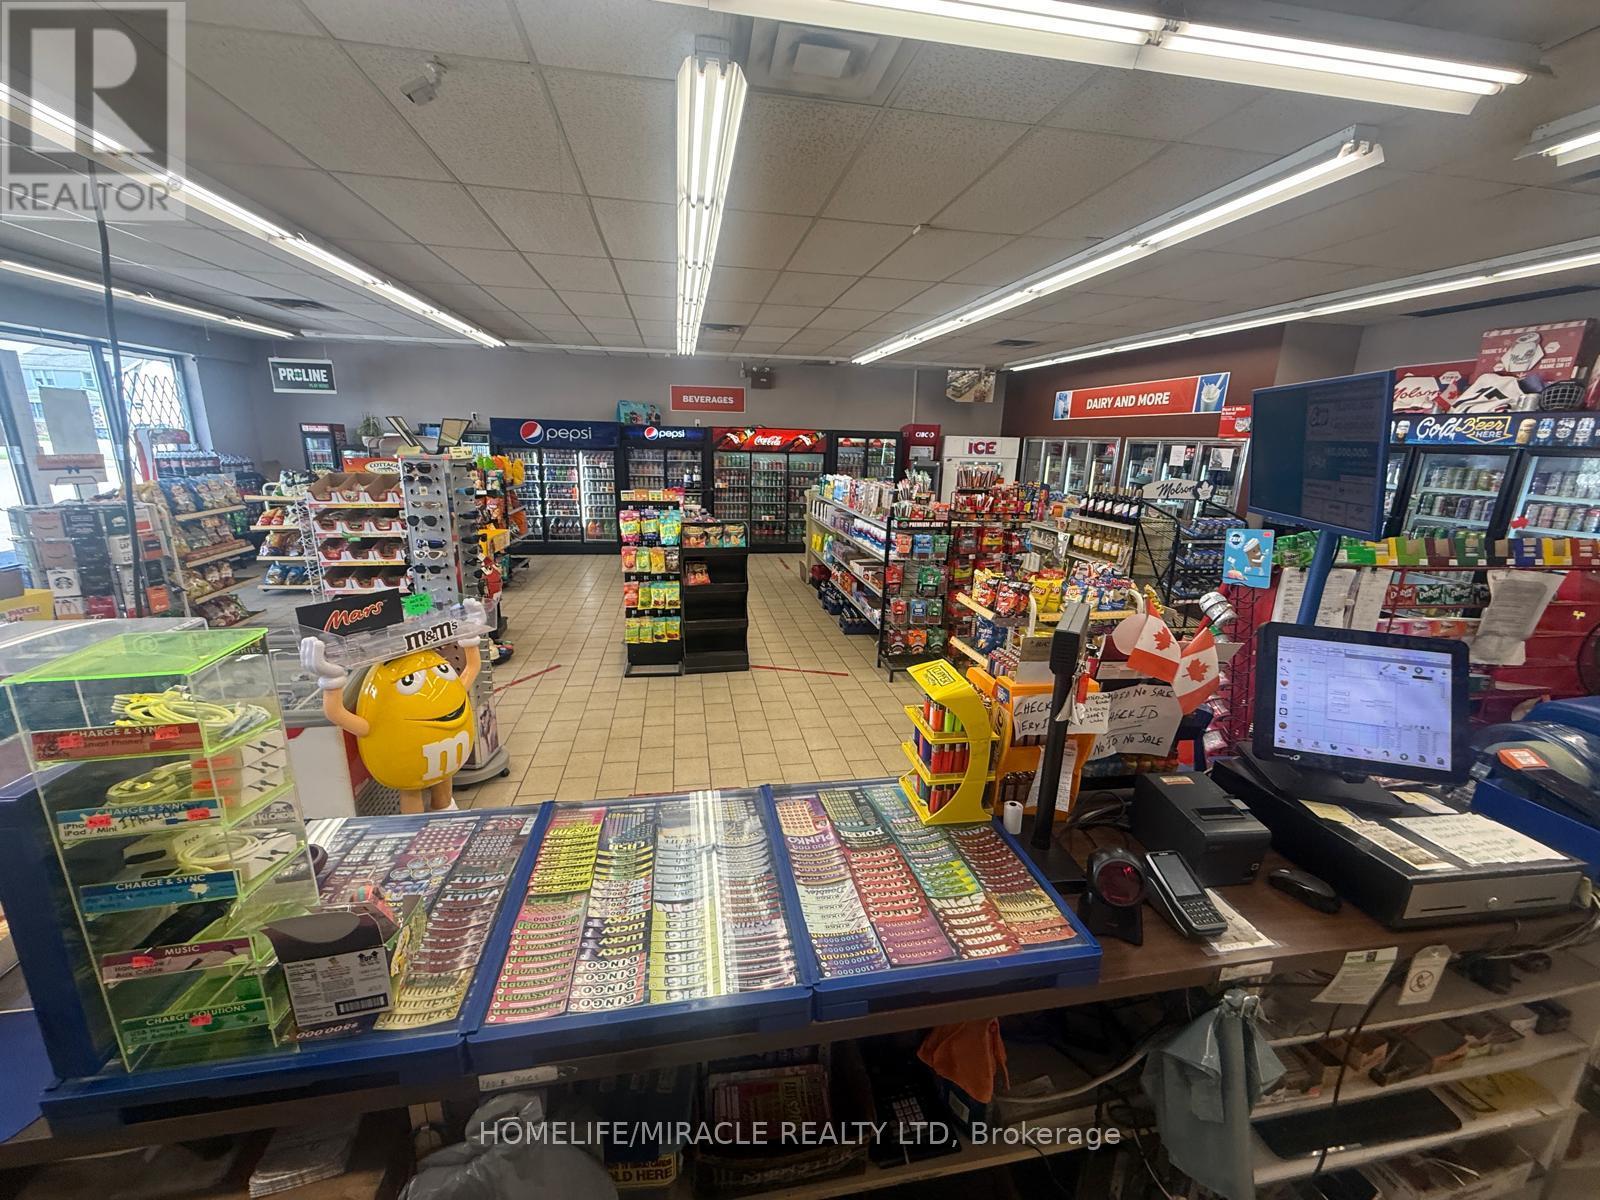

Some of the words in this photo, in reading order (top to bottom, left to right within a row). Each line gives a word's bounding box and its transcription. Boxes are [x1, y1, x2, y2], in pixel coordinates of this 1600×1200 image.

[278, 367, 328, 382] PROLINE
[682, 395, 734, 405] BEVERAGES
[1086, 396, 1114, 410] DAIRY
[1115, 395, 1137, 408] AND
[1138, 392, 1170, 406] MORE
[658, 429, 685, 440] pepsi
[1416, 417, 1462, 440] Cold
[1456, 416, 1505, 432] Beer
[1474, 430, 1503, 438] HERE
[546, 426, 592, 444] pepsi
[968, 442, 997, 455] ICE
[324, 600, 384, 632] Mars
[787, 830, 834, 844] PLINKO
[841, 828, 884, 837] POKER
[851, 848, 896, 859] BINGO
[856, 864, 903, 874] BINGO
[116, 880, 164, 890] CHARGE
[166, 878, 174, 886] &
[448, 874, 506, 883] VAULT
[442, 888, 500, 902] VAULT
[865, 886, 916, 898] BINGO
[928, 894, 985, 908] SPIN
[870, 906, 922, 917] BINGO
[944, 904, 980, 916] BIGGER
[604, 912, 646, 924] LUCKY
[950, 912, 990, 926] BIGGER
[602, 922, 645, 934] LUCKY
[954, 924, 995, 936] BIGGER
[600, 932, 644, 945] LUCKY
[963, 932, 1004, 946] BIGGER
[165, 945, 200, 956] MUSIC
[598, 944, 643, 957] LUCKY
[968, 944, 1011, 957] BIGGER
[586, 956, 639, 970] BINGO
[584, 968, 636, 982] BINGO
[581, 980, 636, 995] BINGO
[579, 992, 636, 1009] BINGO
[146, 1014, 188, 1026] CHARGE
[636, 1166, 672, 1181] HERE
